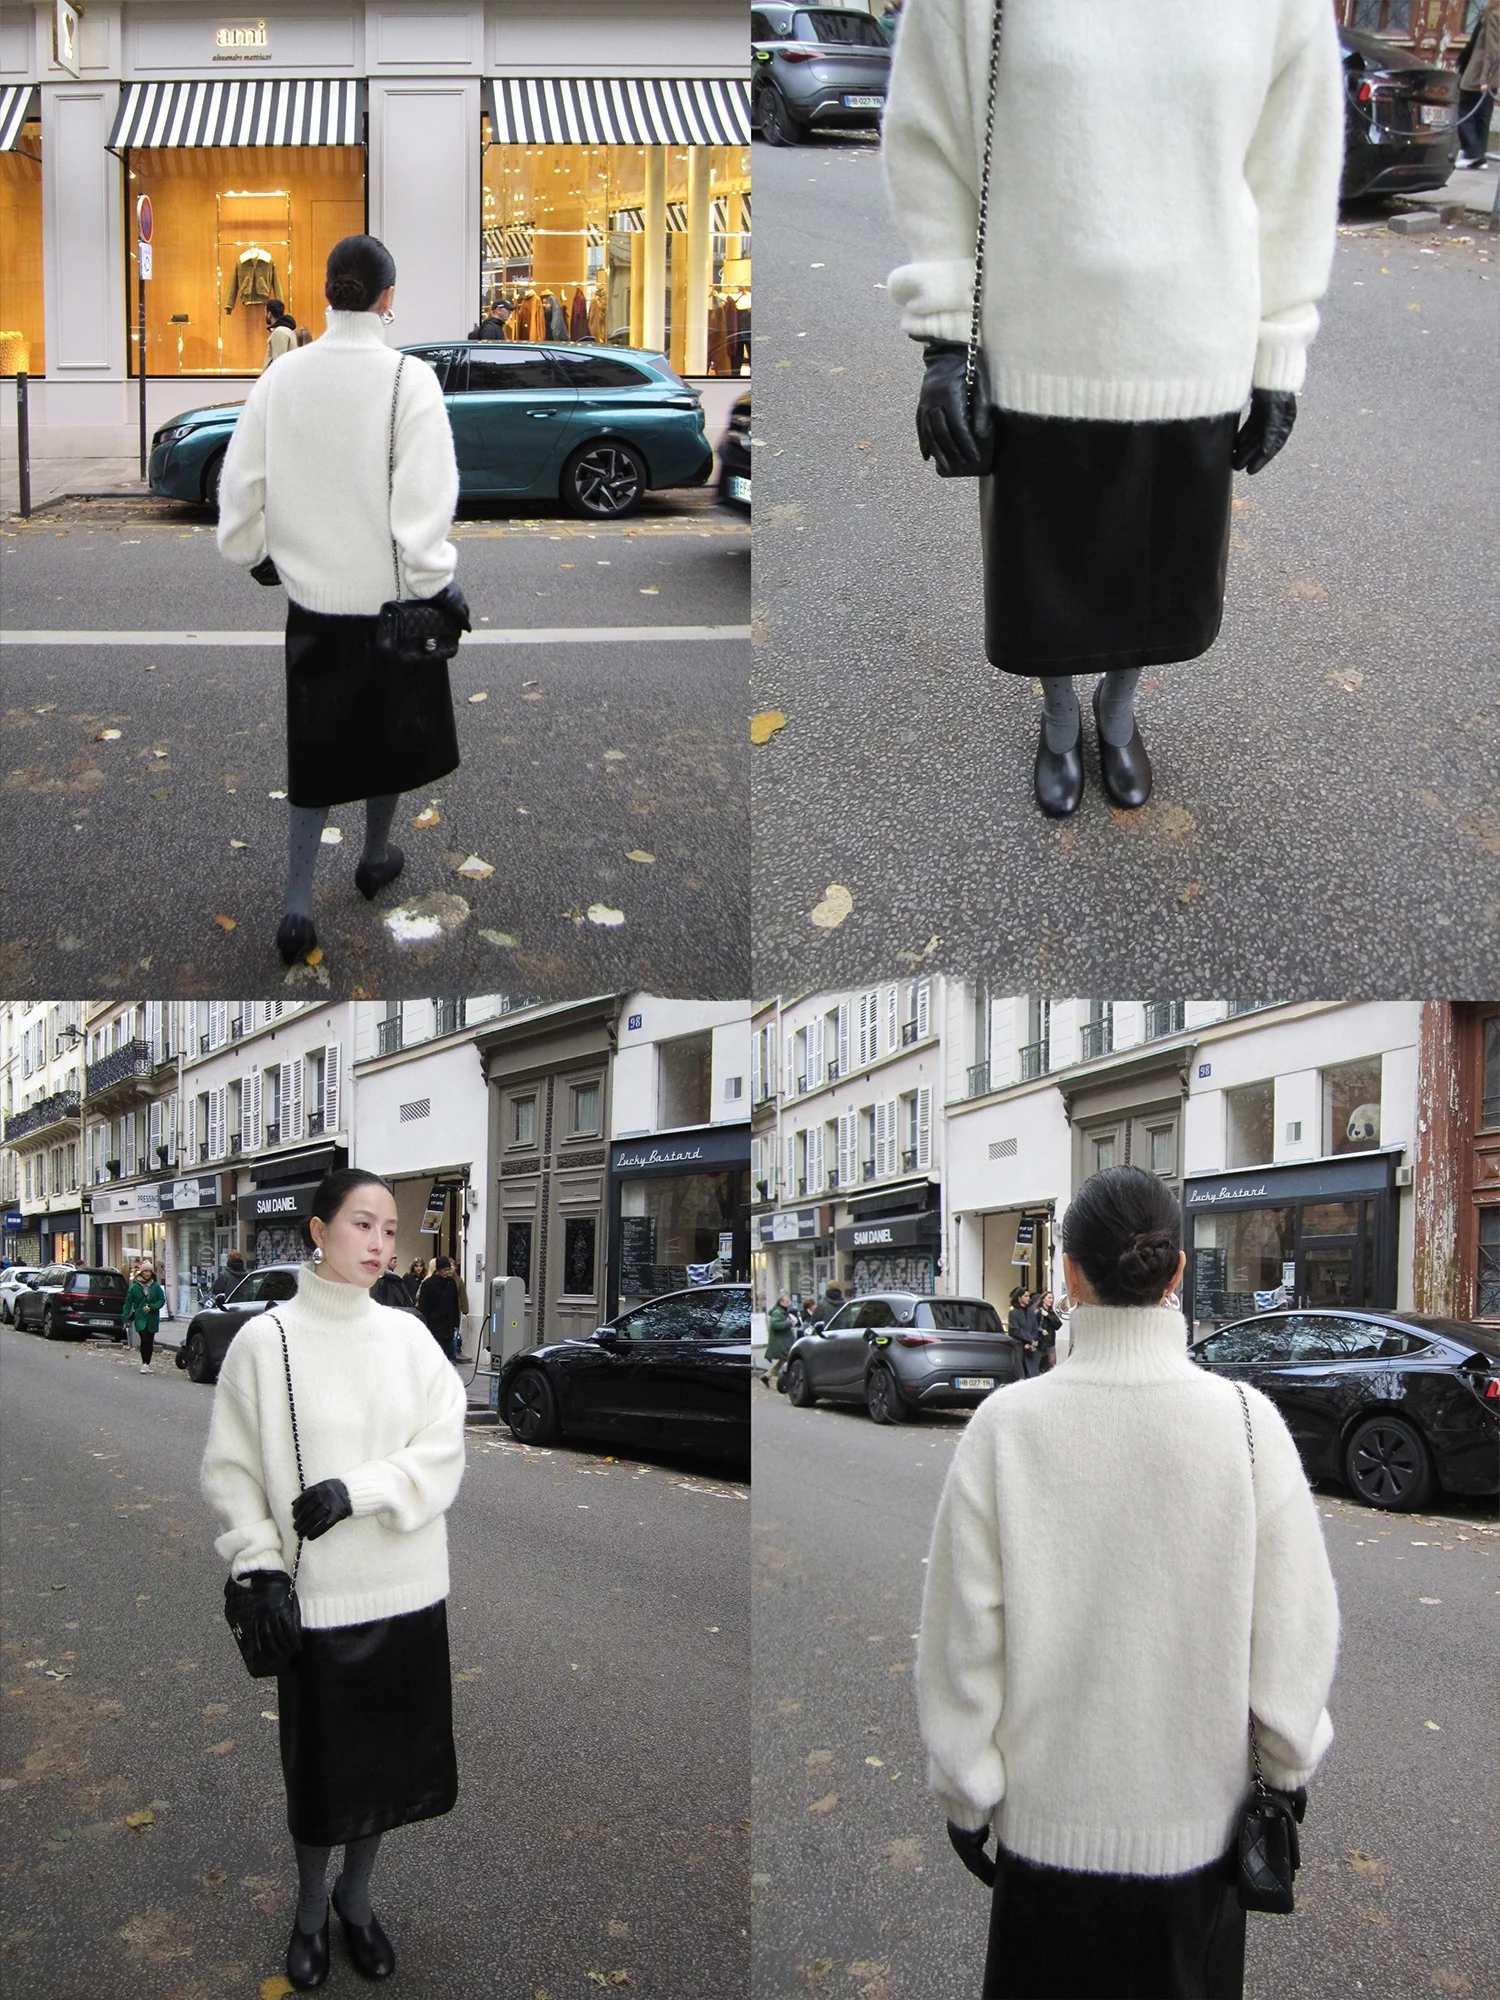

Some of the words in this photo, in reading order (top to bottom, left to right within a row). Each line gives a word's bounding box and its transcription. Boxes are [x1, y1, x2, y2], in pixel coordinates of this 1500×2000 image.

[216, 21, 268, 47] ami
[630, 1016, 641, 1029] 98
[1200, 1065, 1210, 1077] 98
[617, 1153, 646, 1168] Lucky
[648, 1147, 702, 1165] Bastard
[138, 1195, 160, 1203] PRESSING
[1189, 1189, 1216, 1203] Lucky
[1218, 1185, 1268, 1200] Bastard
[257, 1198, 271, 1214] SAM
[272, 1196, 297, 1212] DANIEL
[854, 1231, 868, 1245] SAM
[869, 1228, 893, 1243] DANIEL
